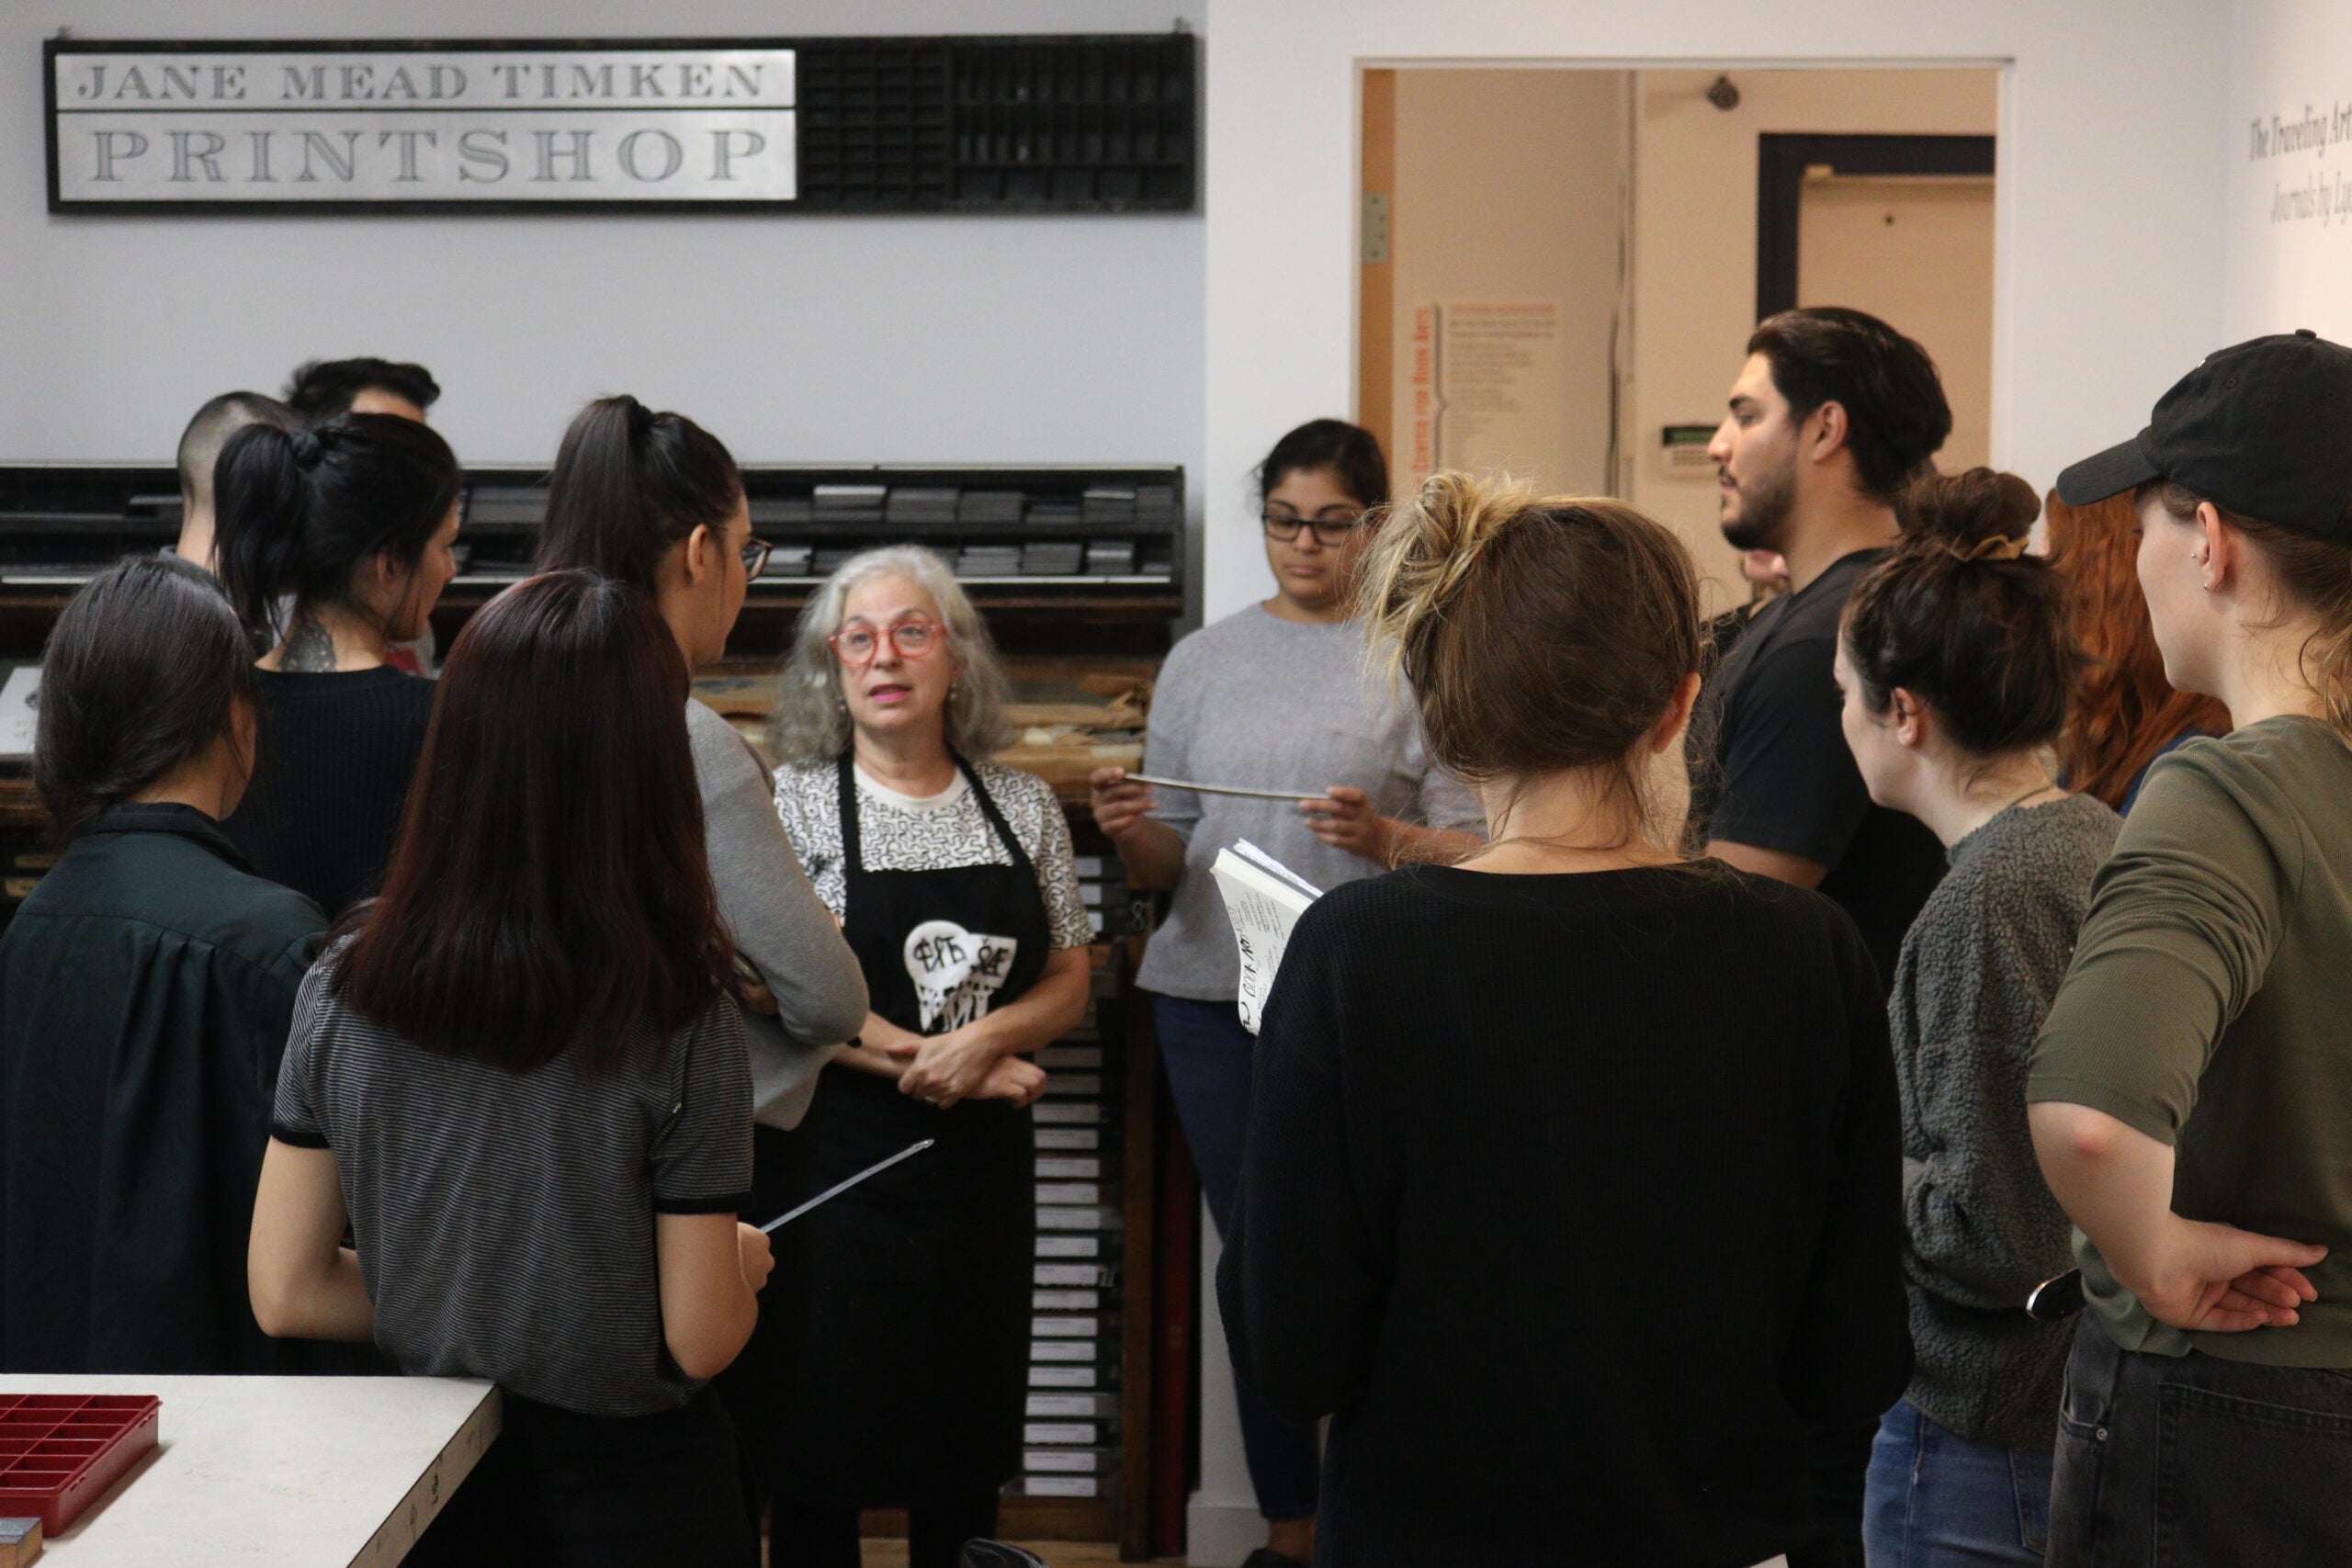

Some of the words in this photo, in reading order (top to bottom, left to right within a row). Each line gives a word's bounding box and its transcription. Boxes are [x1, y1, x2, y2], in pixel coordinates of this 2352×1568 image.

[77, 64, 246, 100] JANE
[279, 63, 468, 100] MEAD
[492, 63, 764, 99] TIMKEN
[89, 128, 768, 183] PRINTSHOP
